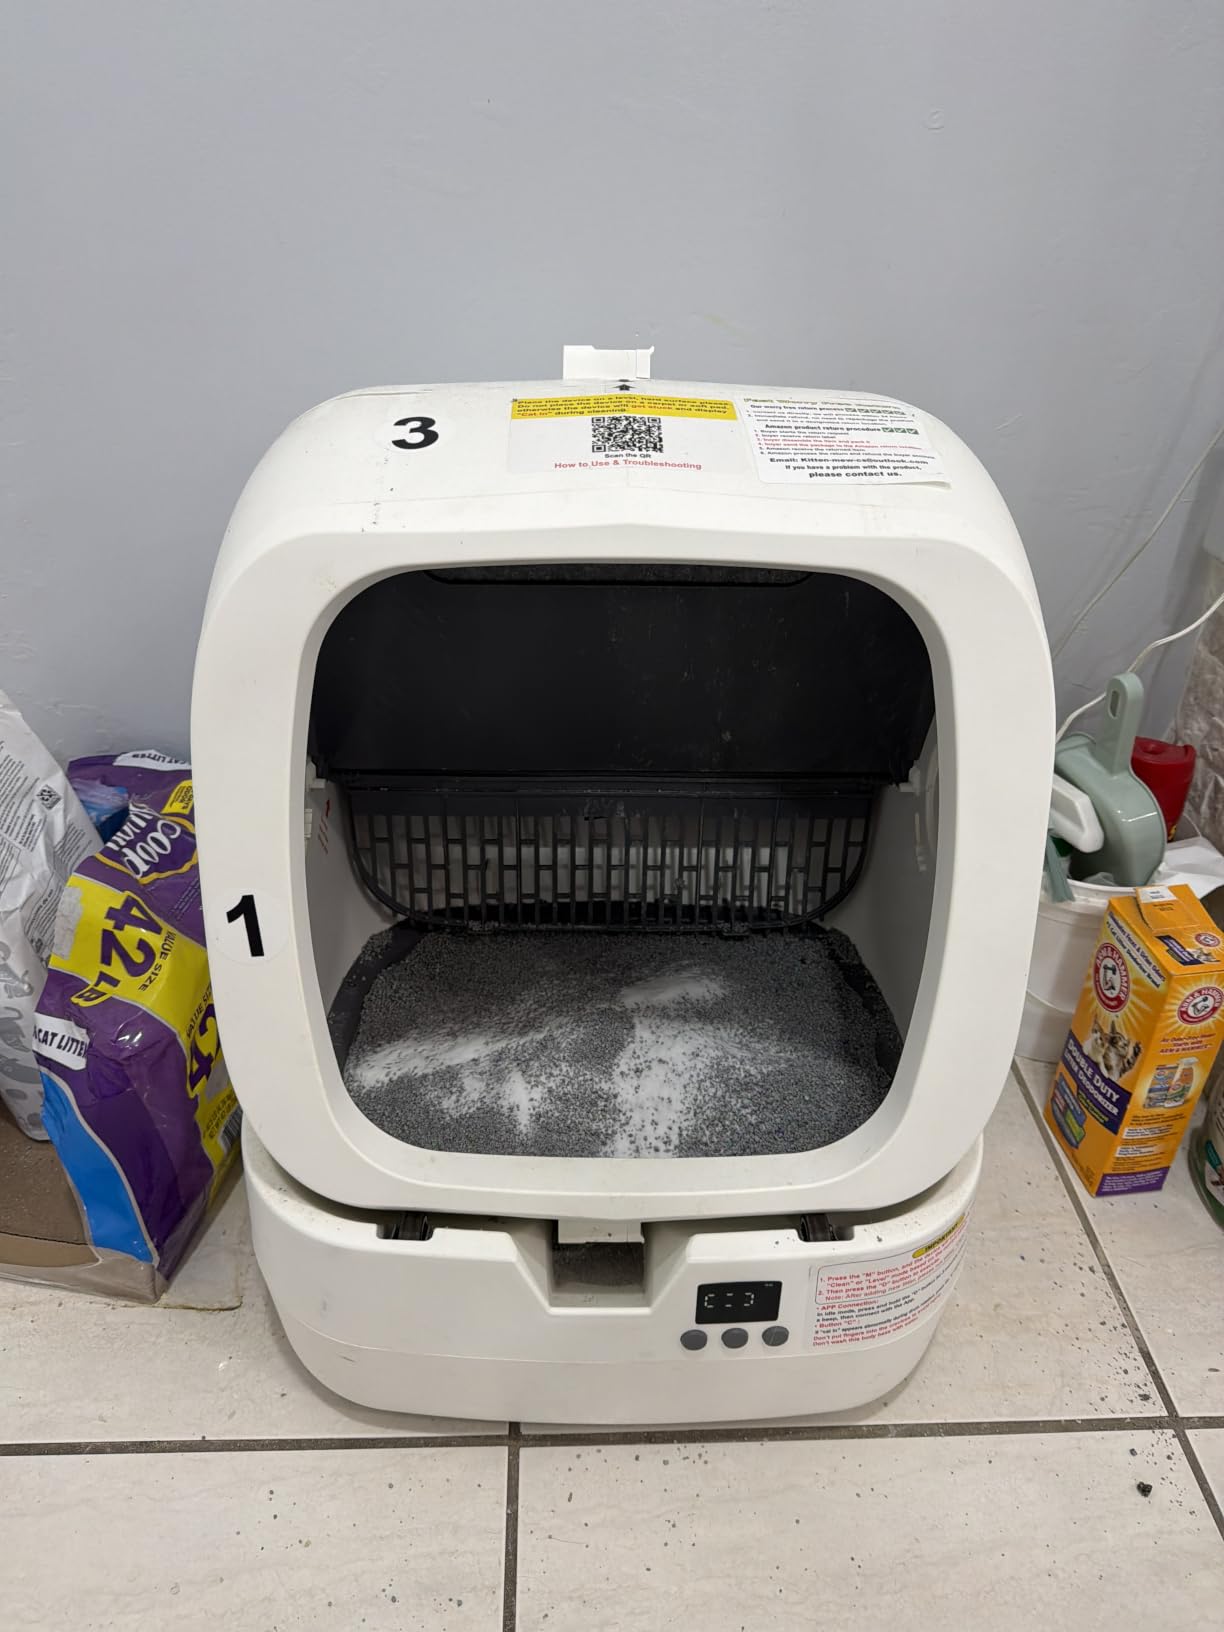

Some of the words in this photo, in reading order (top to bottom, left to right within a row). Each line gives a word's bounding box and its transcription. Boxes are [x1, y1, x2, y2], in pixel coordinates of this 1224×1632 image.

[392, 416, 439, 450] 3
[623, 460, 702, 470] Troubleshooting
[101, 895, 162, 978] 42
[226, 894, 264, 956] 1
[160, 931, 176, 960] VALUE
[138, 963, 162, 992] SIZE
[1112, 950, 1129, 1000] HAMMER
[38, 1028, 58, 1046] CAT
[1068, 1038, 1094, 1079] DOUBLE
[1093, 1074, 1120, 1103] DUTY
[1078, 1072, 1119, 1116] DEODORIZER
[865, 1275, 889, 1284] "Level"
[838, 1300, 879, 1309] Connection:
